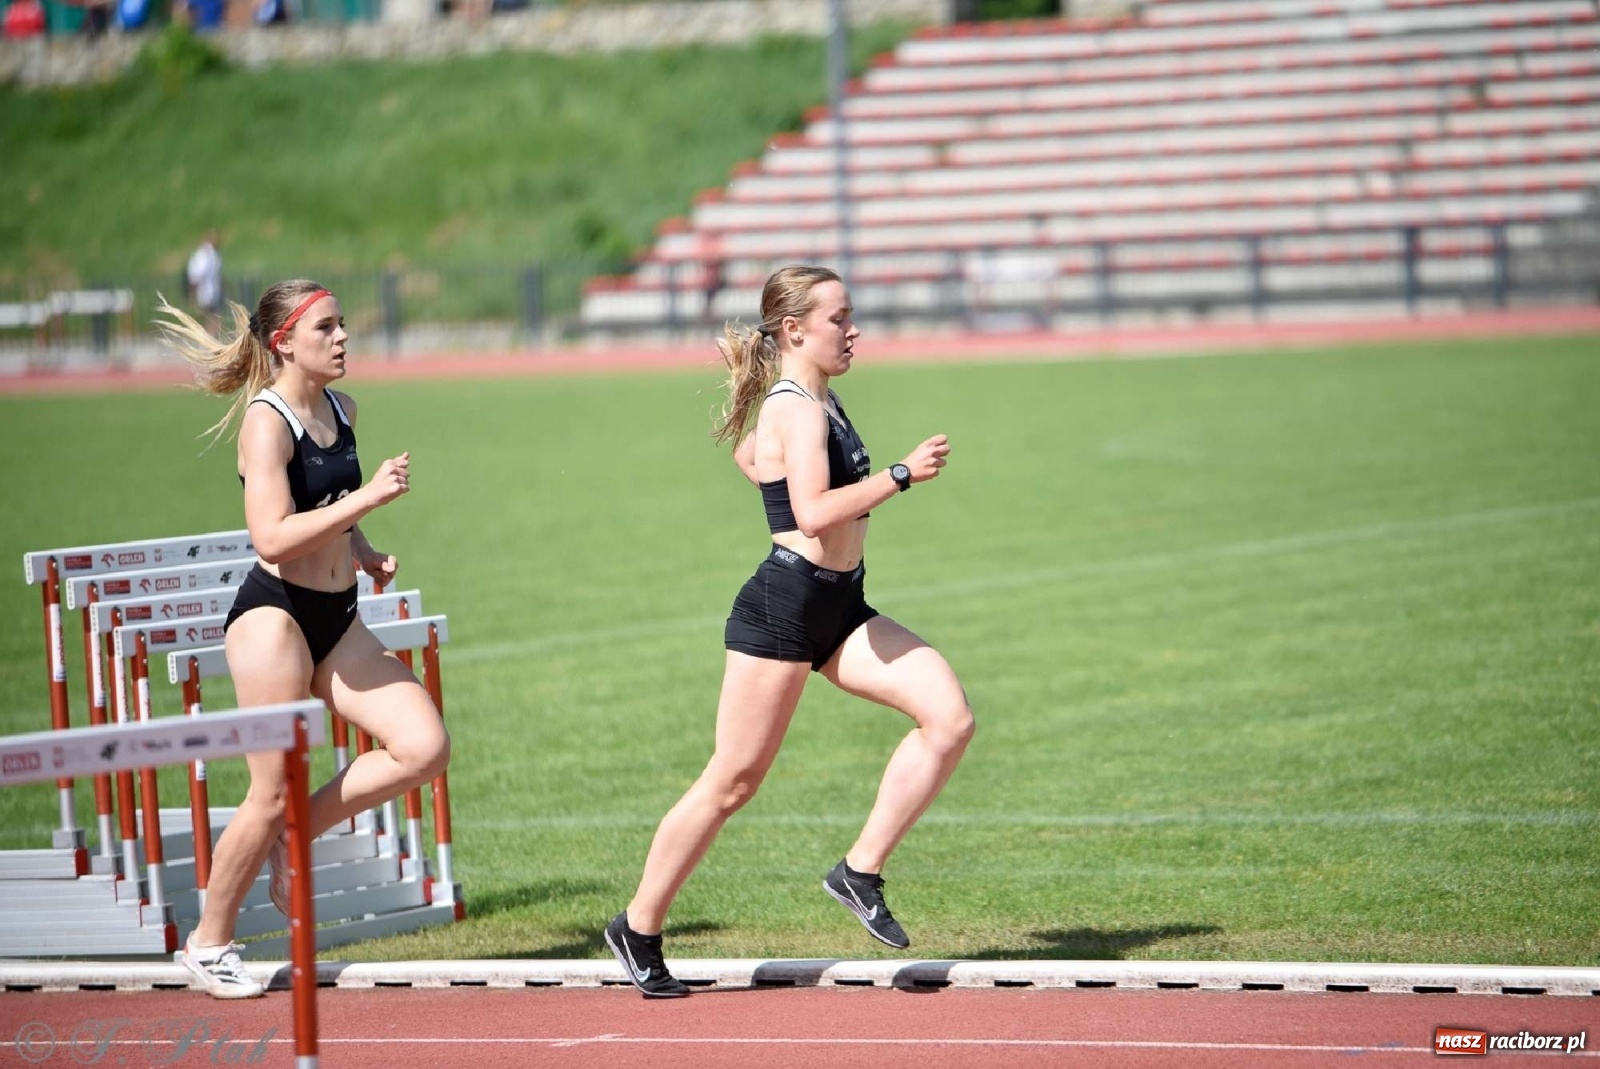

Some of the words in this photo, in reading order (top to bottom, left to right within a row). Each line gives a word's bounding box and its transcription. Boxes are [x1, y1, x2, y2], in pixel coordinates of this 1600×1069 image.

[119, 552, 145, 565] ORLEN
[156, 577, 180, 591] ORLEN
[178, 603, 202, 616] ORLEN
